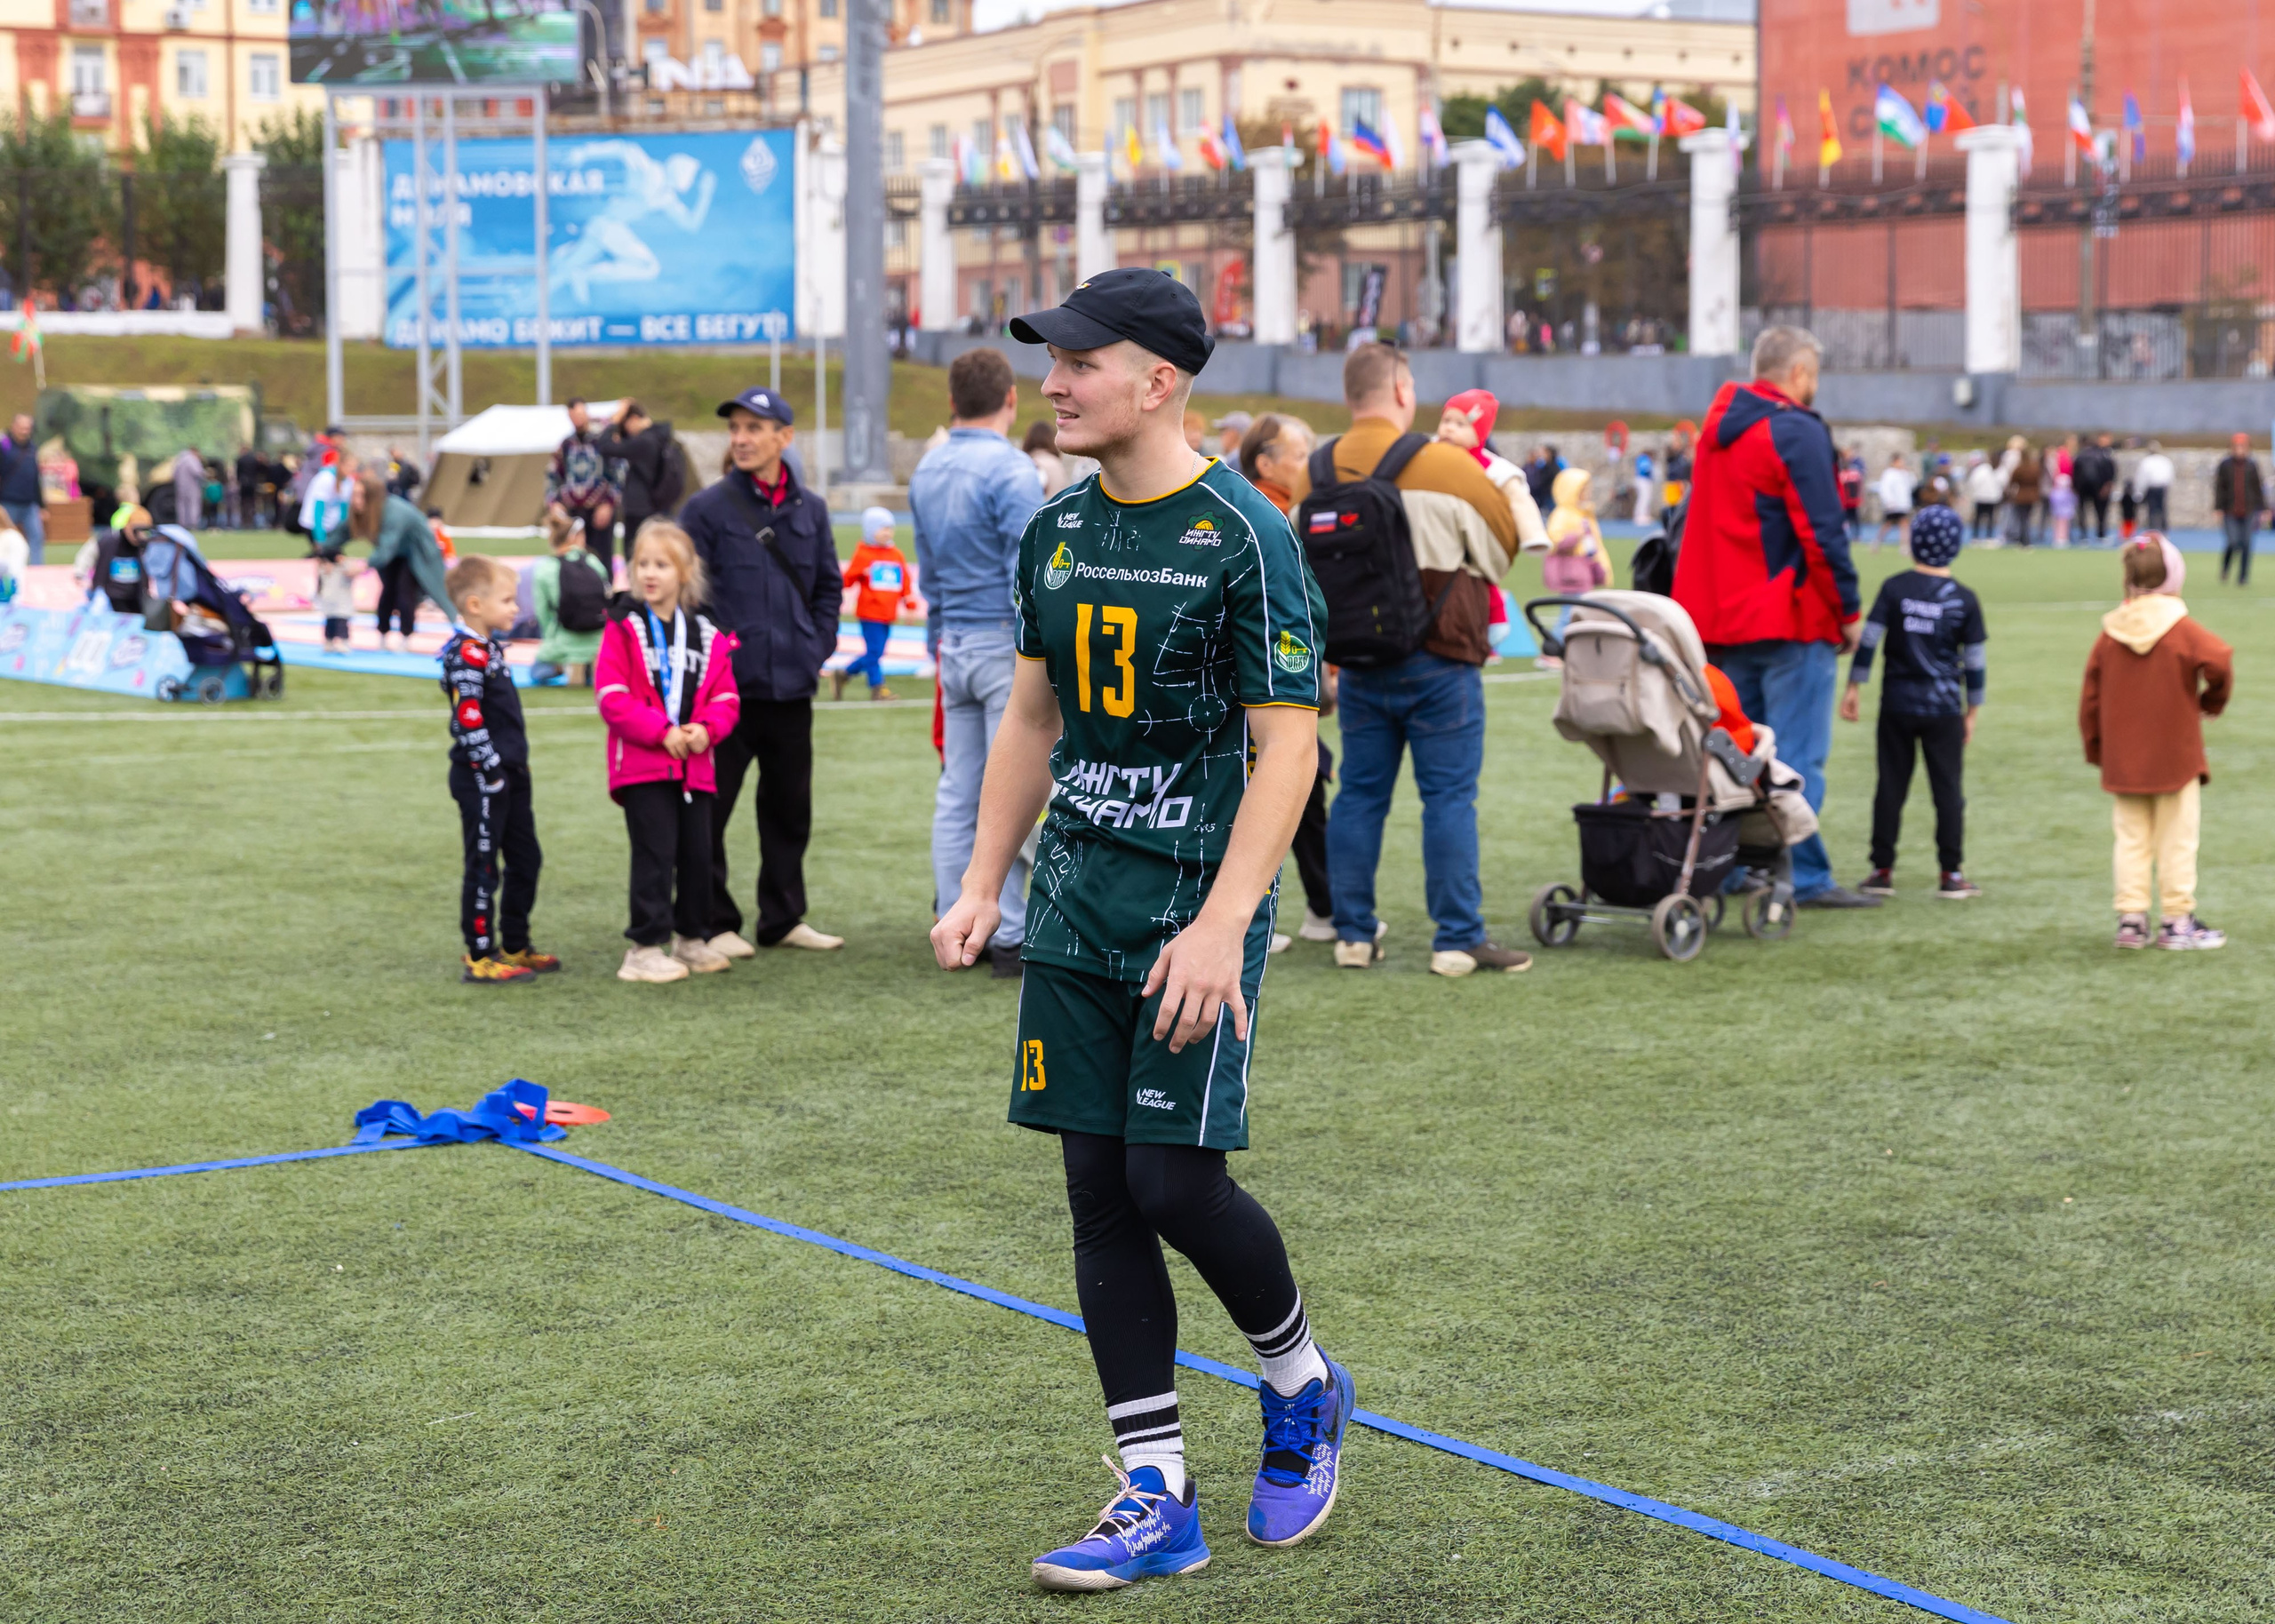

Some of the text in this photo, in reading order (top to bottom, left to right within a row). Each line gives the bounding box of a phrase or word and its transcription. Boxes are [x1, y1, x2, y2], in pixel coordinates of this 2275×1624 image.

[641, 314, 689, 340] ВСЕ
[1185, 529, 1221, 539] ИЖГТУ
[1074, 561, 1209, 588] РоссельхозБанк
[1075, 603, 1138, 718] 13
[1020, 1039, 1047, 1092] 13
[1137, 1095, 1177, 1111] LEAGUE
[1141, 1088, 1166, 1100] NEW
